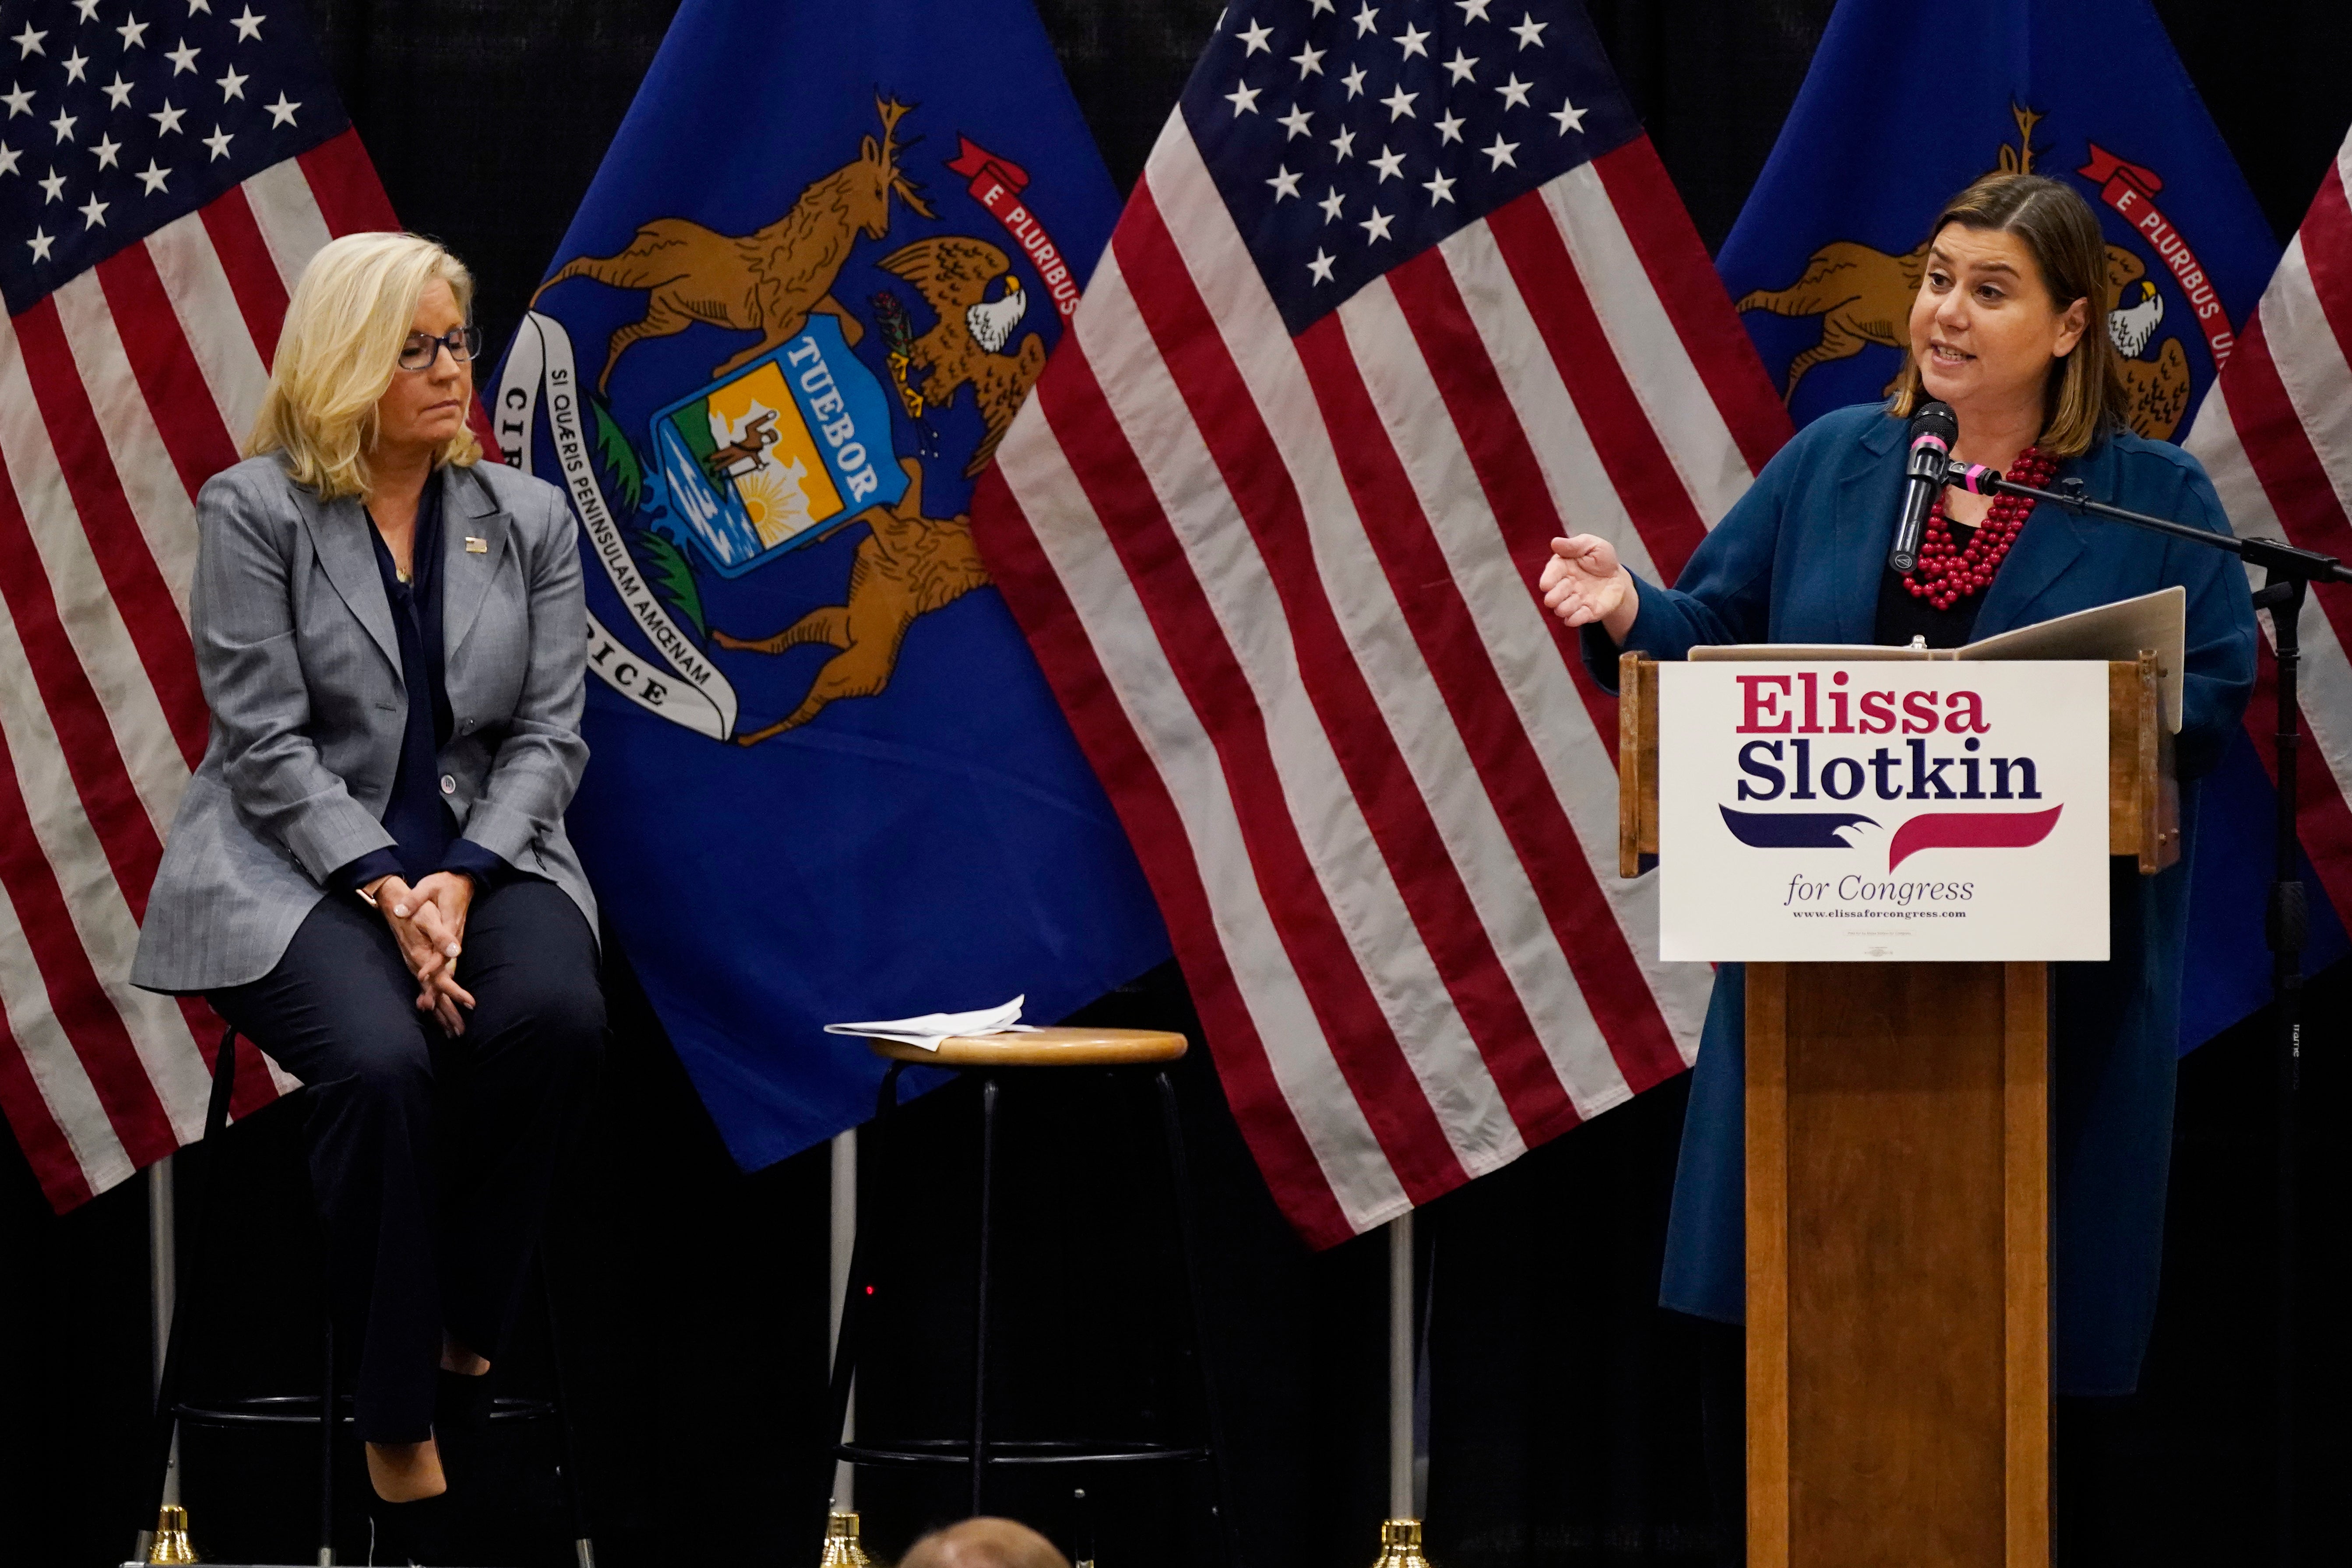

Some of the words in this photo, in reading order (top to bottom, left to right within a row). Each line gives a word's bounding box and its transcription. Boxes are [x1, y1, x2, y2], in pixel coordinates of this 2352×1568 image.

[983, 183, 1004, 207] E
[1004, 206, 1081, 316] PLURIBUS
[2116, 189, 2137, 211] E
[2139, 212, 2220, 320] PLURIBUS
[788, 336, 878, 503] TUEBOR
[552, 368, 569, 387] SI
[573, 477, 641, 597] PENINSULAM
[1736, 670, 1992, 735] Elissa
[1737, 737, 2042, 801] Slotkin
[1784, 874, 1830, 906] for
[1838, 875, 1974, 906] Congress
[1793, 909, 1966, 920] www.elissaforcongress.com
